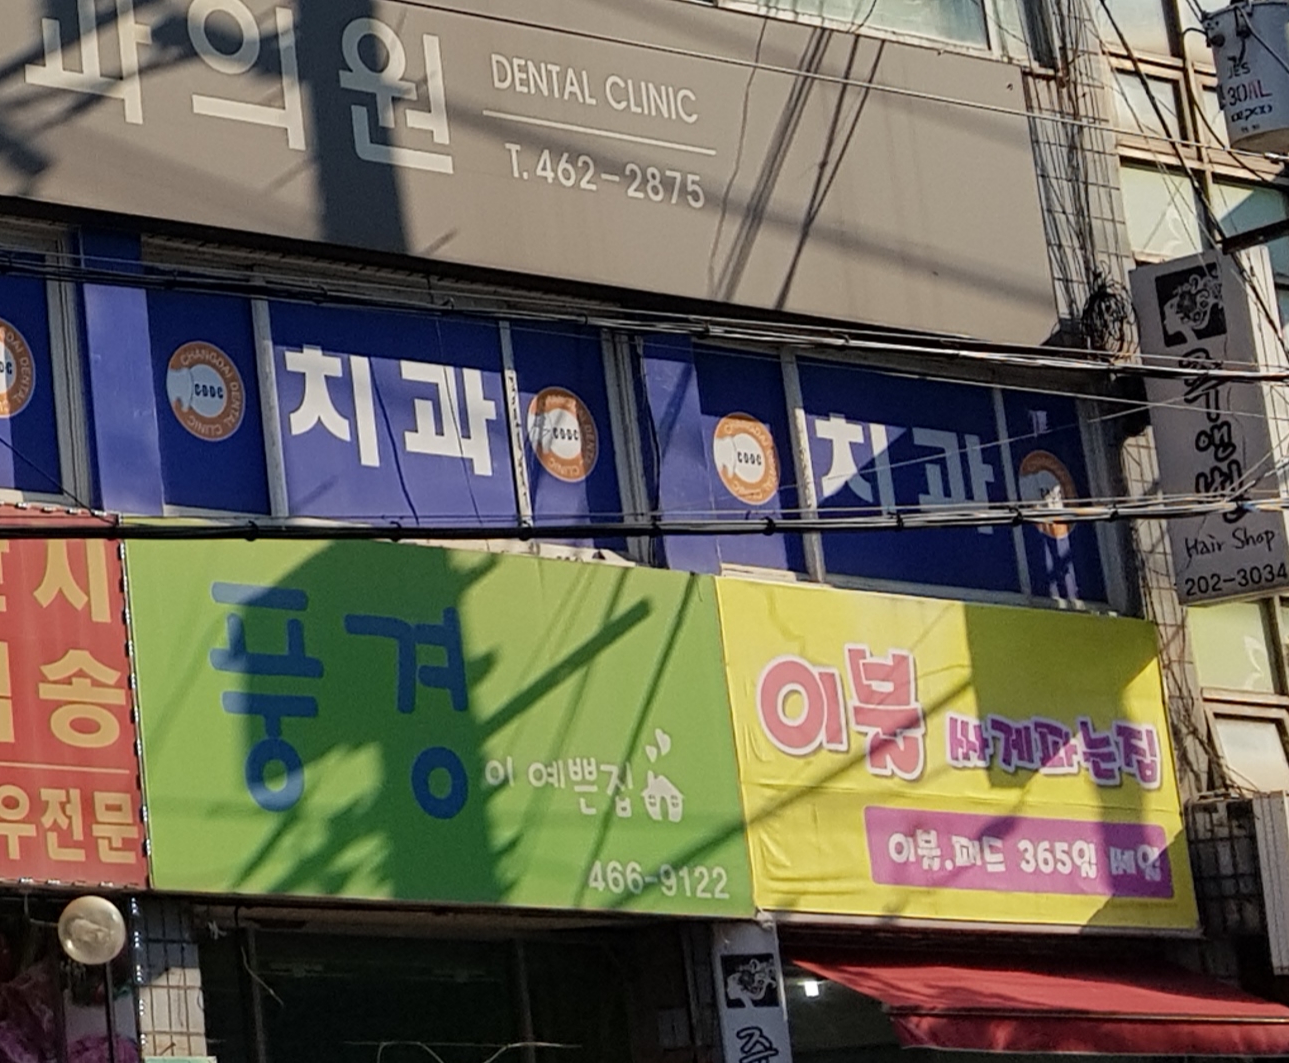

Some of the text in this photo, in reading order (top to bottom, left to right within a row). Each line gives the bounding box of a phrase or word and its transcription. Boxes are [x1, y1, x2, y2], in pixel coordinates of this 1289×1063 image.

[490, 52, 699, 125] DENTAL CLINIC
[284, 344, 498, 477] 치과
[814, 413, 994, 534] 치과
[1185, 527, 1275, 559] Hair Shop
[1185, 562, 1288, 597] 202-3034
[210, 581, 469, 819] 풍경
[757, 643, 925, 780] 이불
[528, 757, 633, 818] 예쁜집
[588, 860, 729, 900] 466-9122
[1017, 839, 1098, 879] 365일
